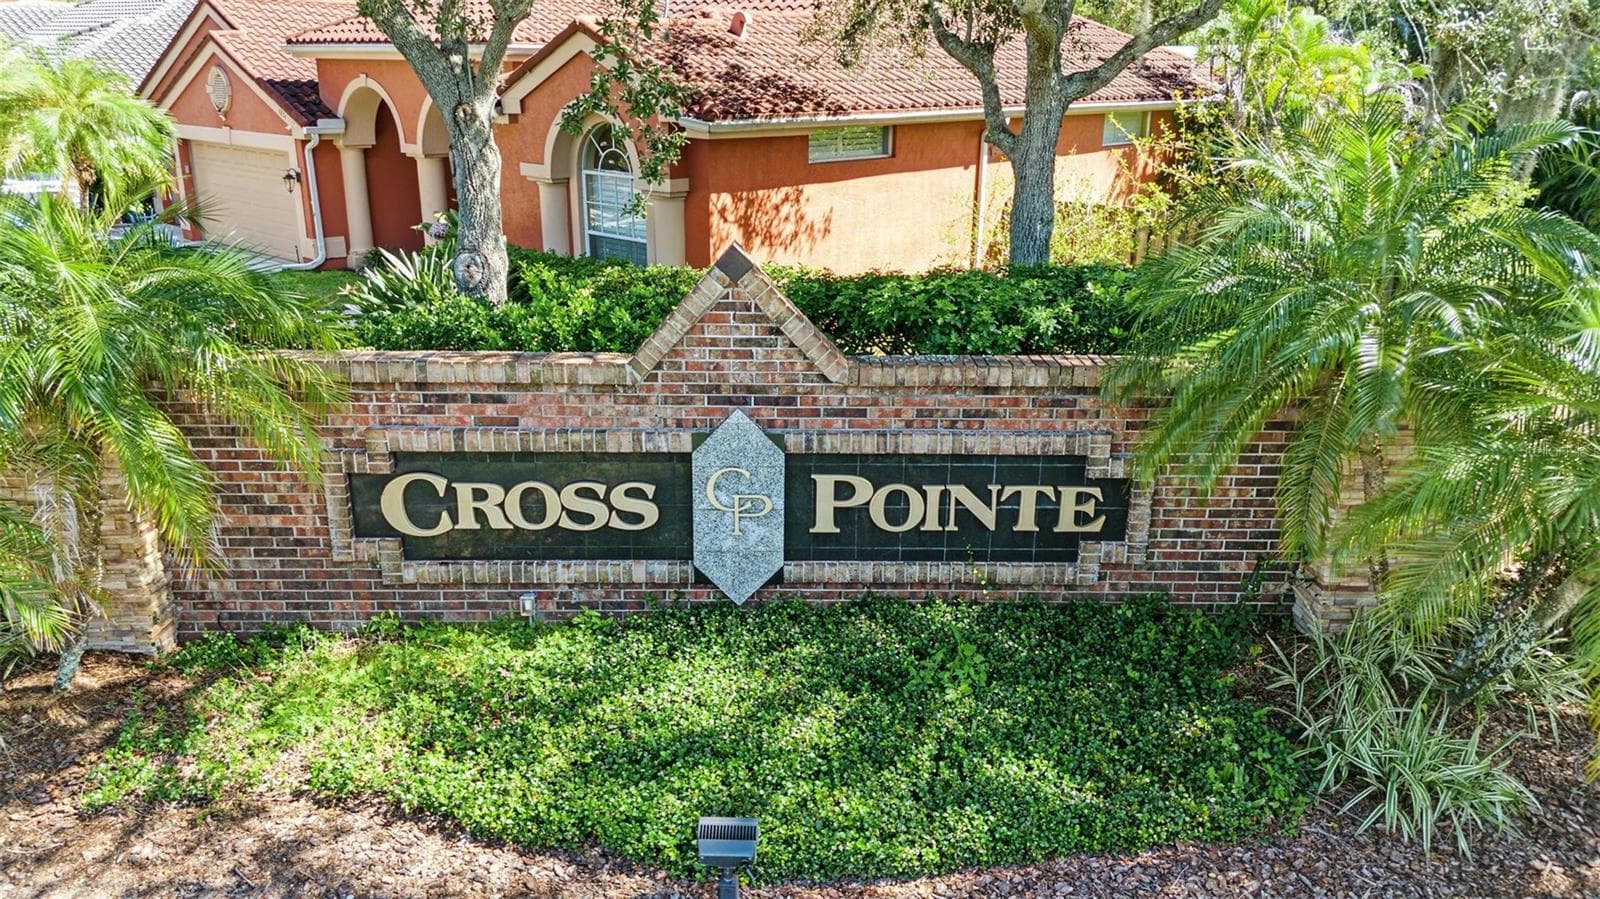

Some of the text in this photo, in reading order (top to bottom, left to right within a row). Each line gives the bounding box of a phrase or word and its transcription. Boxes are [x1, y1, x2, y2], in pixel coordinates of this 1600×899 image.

[380, 471, 1106, 537] CROSS POINTE
[705, 467, 773, 536] CP
